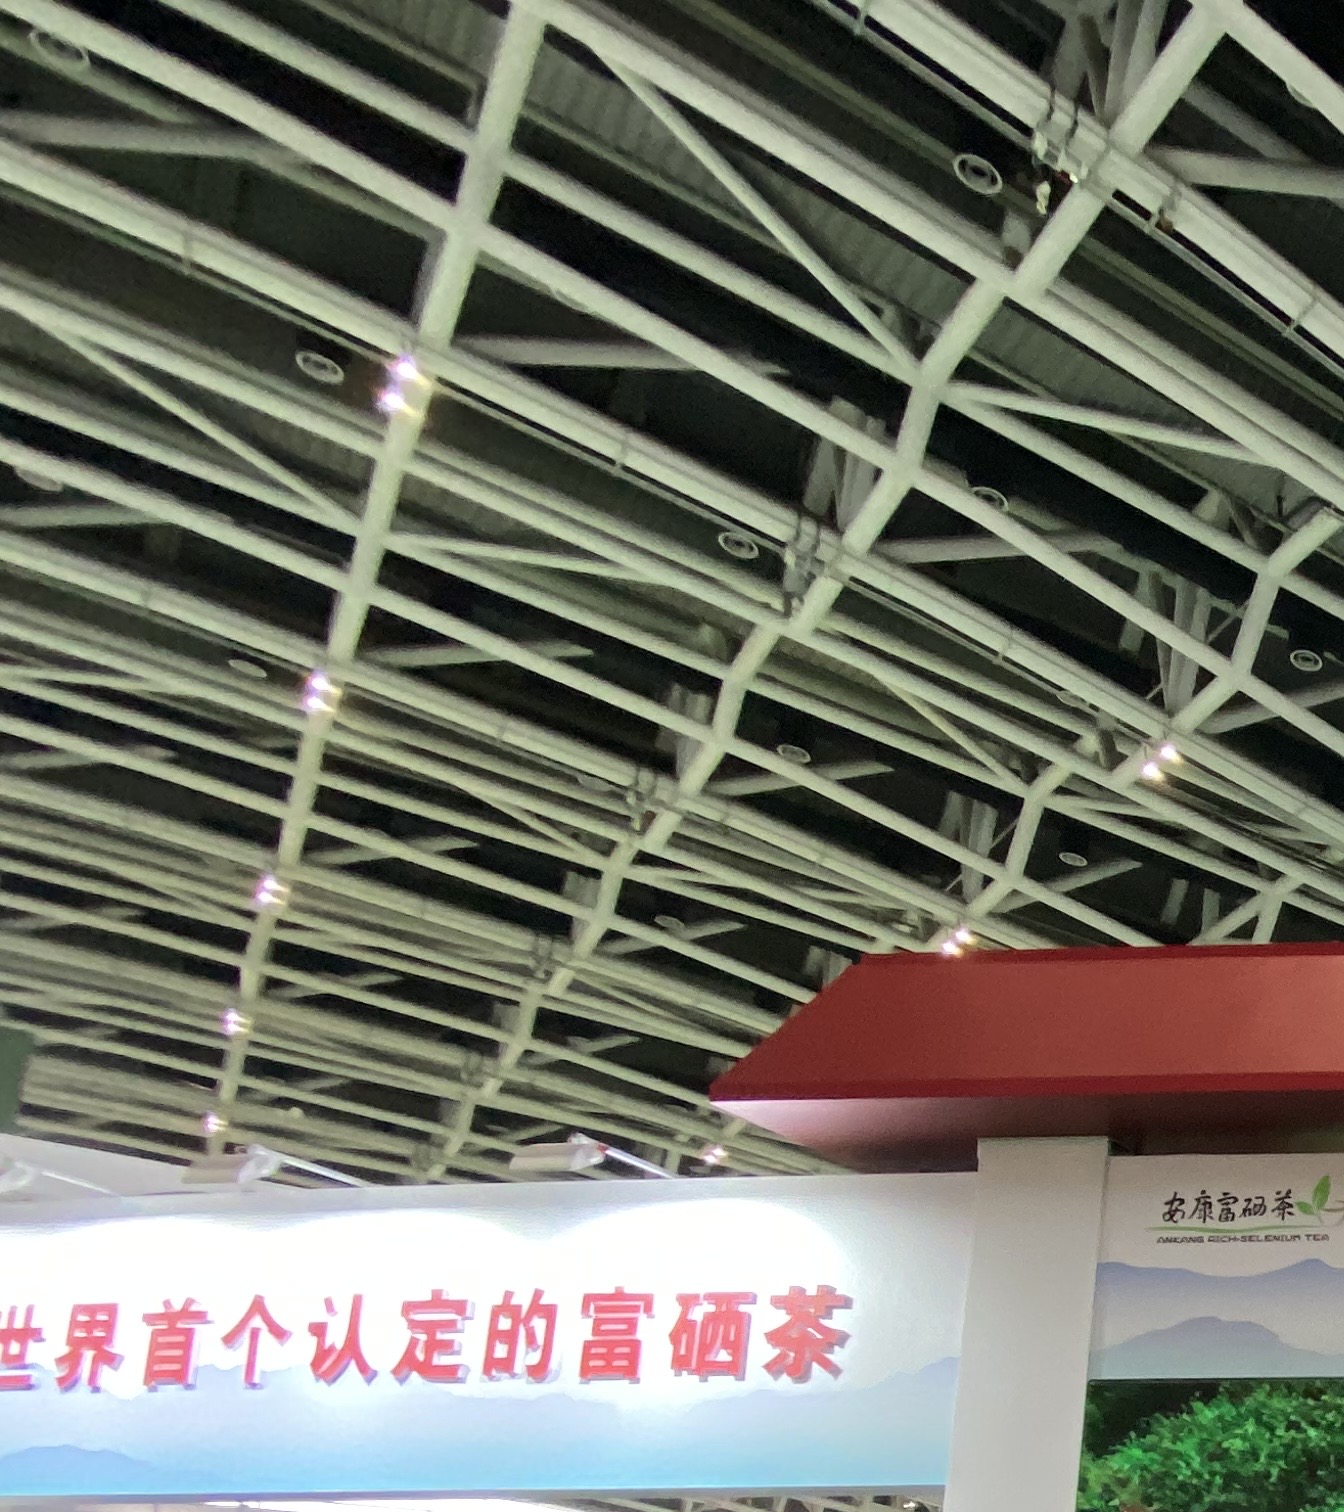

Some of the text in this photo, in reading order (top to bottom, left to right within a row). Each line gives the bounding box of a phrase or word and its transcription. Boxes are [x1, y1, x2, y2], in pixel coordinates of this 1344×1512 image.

[1162, 1189, 1295, 1223] 安康富硒茶
[1305, 1233, 1329, 1242] TEA
[0, 1285, 852, 1391] 世界首个认定的富硒茶
